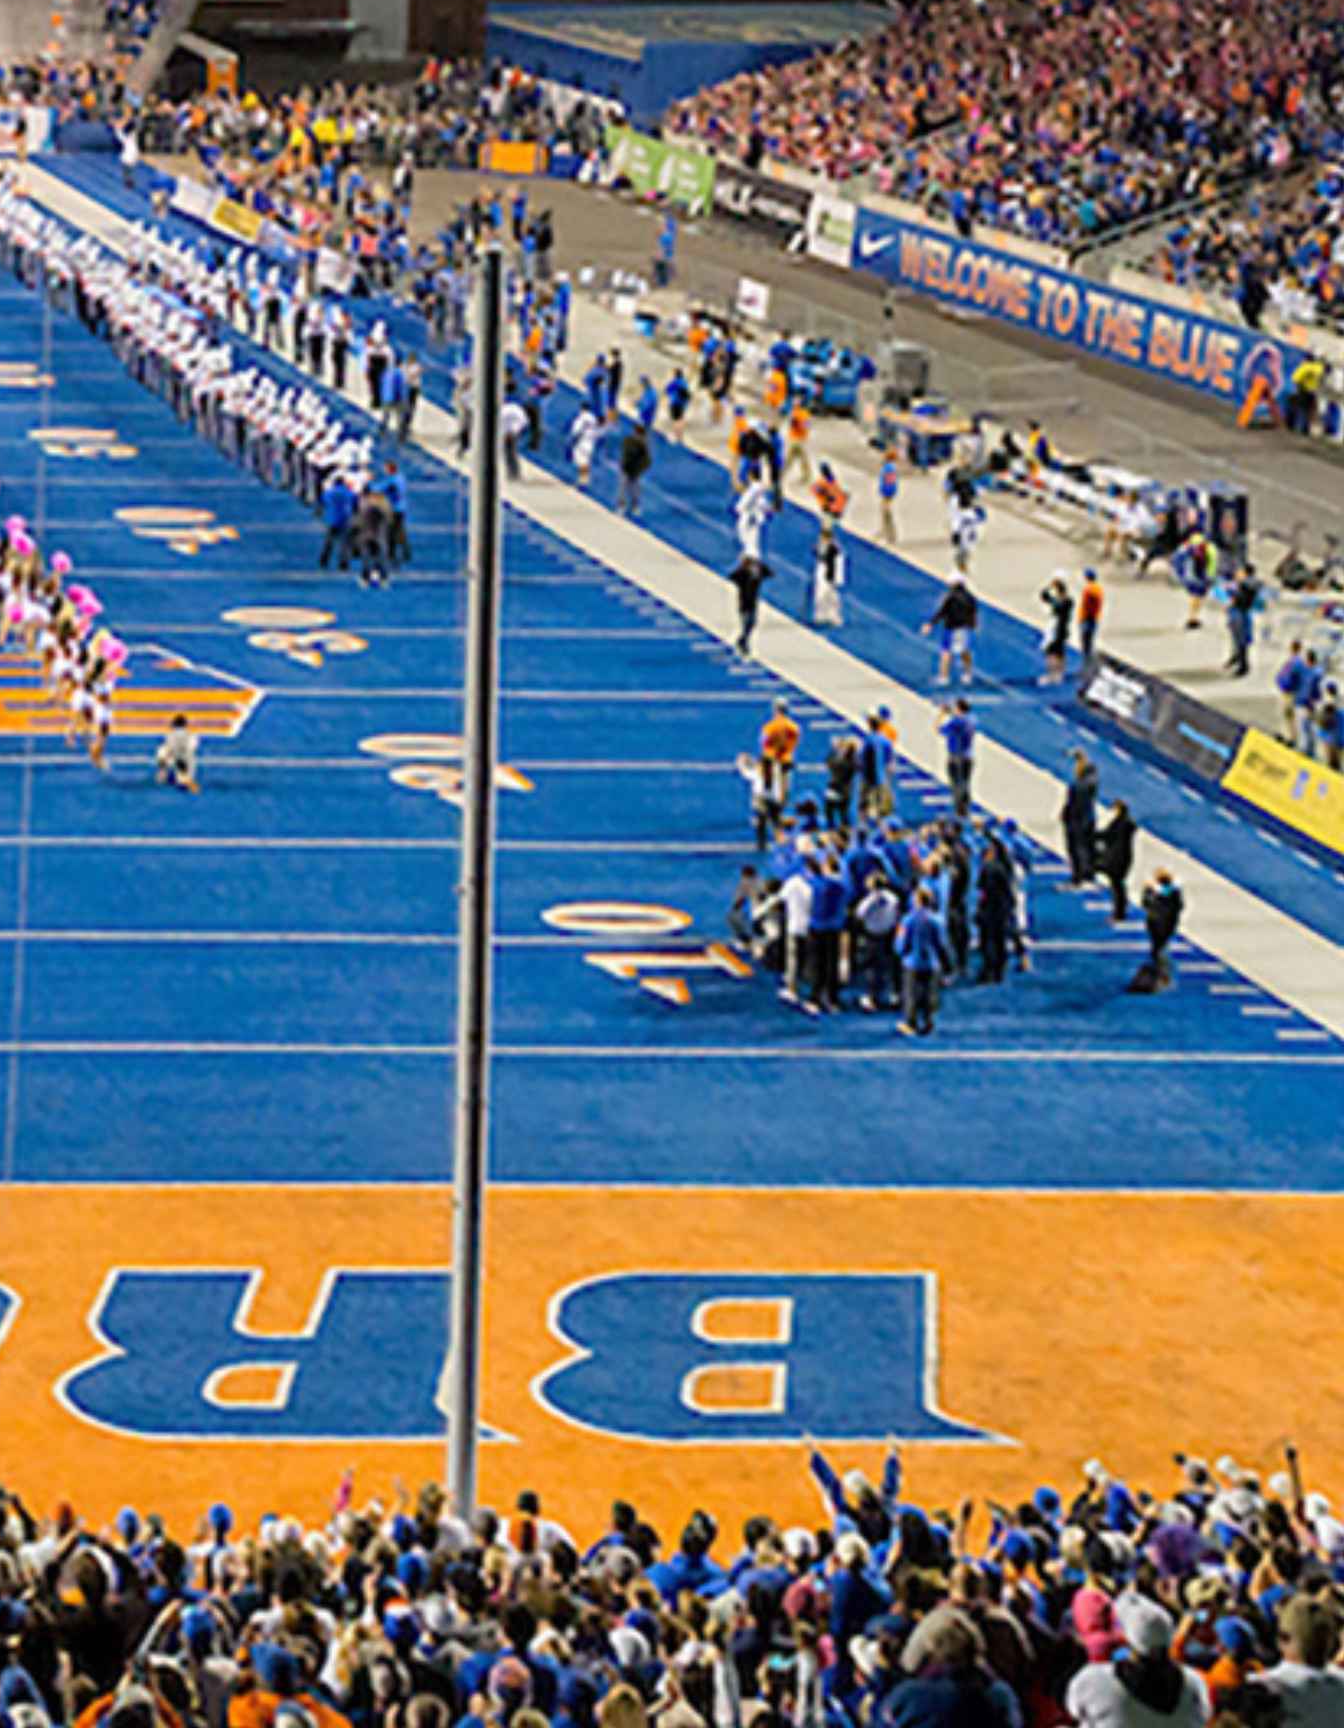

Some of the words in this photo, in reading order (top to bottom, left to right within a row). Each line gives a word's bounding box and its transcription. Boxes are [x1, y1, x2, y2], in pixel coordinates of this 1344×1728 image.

[899, 229, 1033, 320] WELCOME
[1037, 275, 1079, 334] TO
[1085, 289, 1146, 360] THE
[1147, 312, 1241, 392] BLUE
